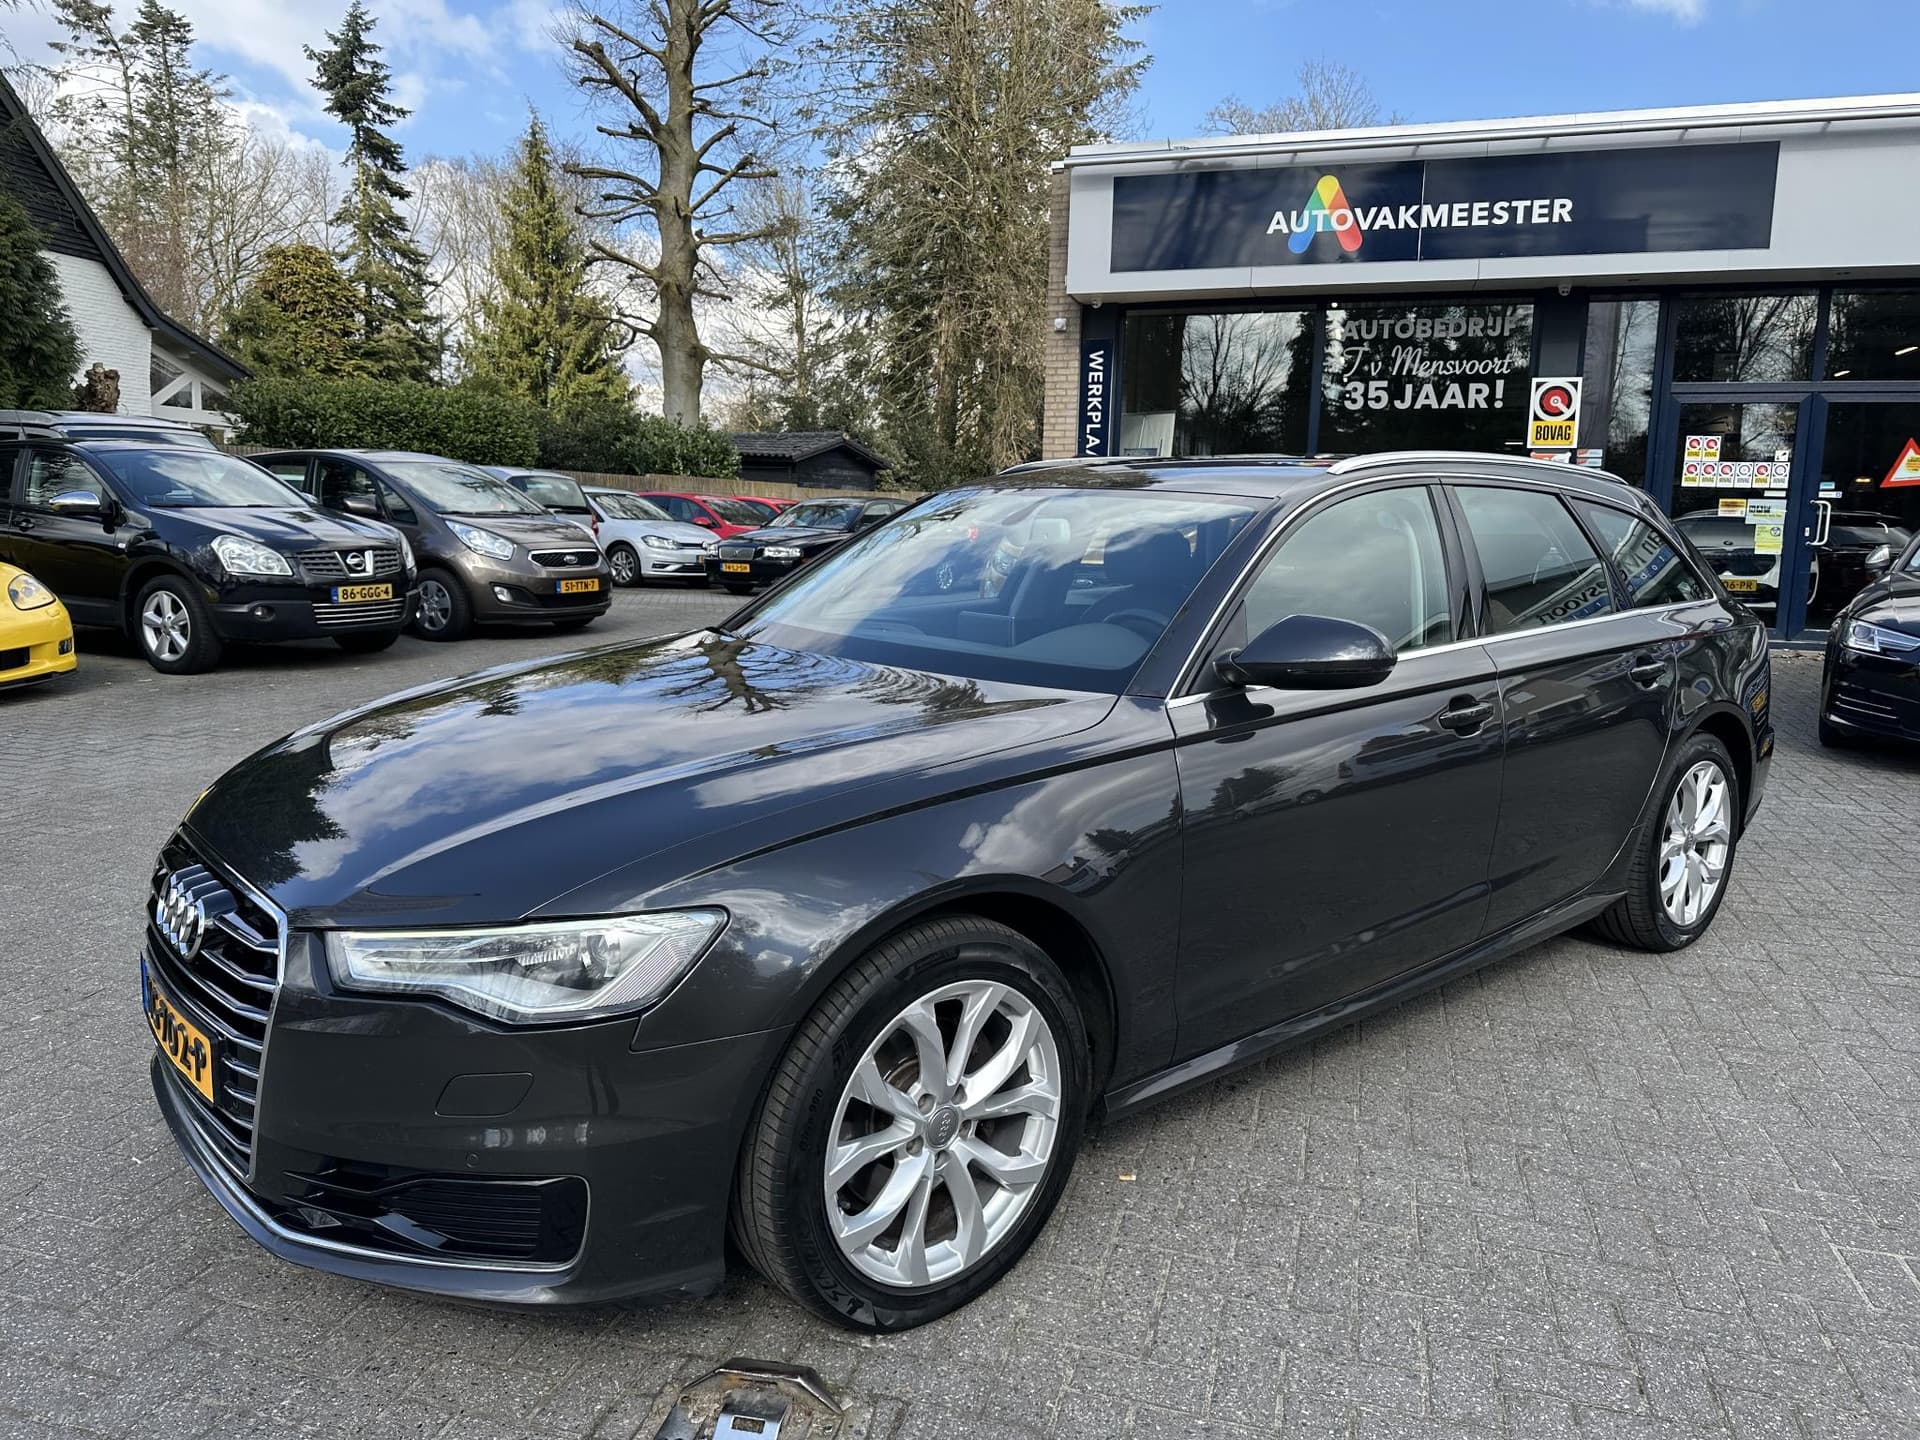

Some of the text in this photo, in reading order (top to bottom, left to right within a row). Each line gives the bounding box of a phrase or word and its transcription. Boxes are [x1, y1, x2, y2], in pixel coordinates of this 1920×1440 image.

[1266, 198, 1573, 235] AUTOVAKMEESTER
[1343, 317, 1516, 341] AUTOBEDRIJF
[1391, 345, 1512, 376] Mensvoort
[1344, 379, 1505, 410] 35 JAAR!
[1535, 425, 1572, 441] BOVAG
[341, 586, 390, 600] 86-GGG-4
[564, 580, 595, 591] 51-TTN-7
